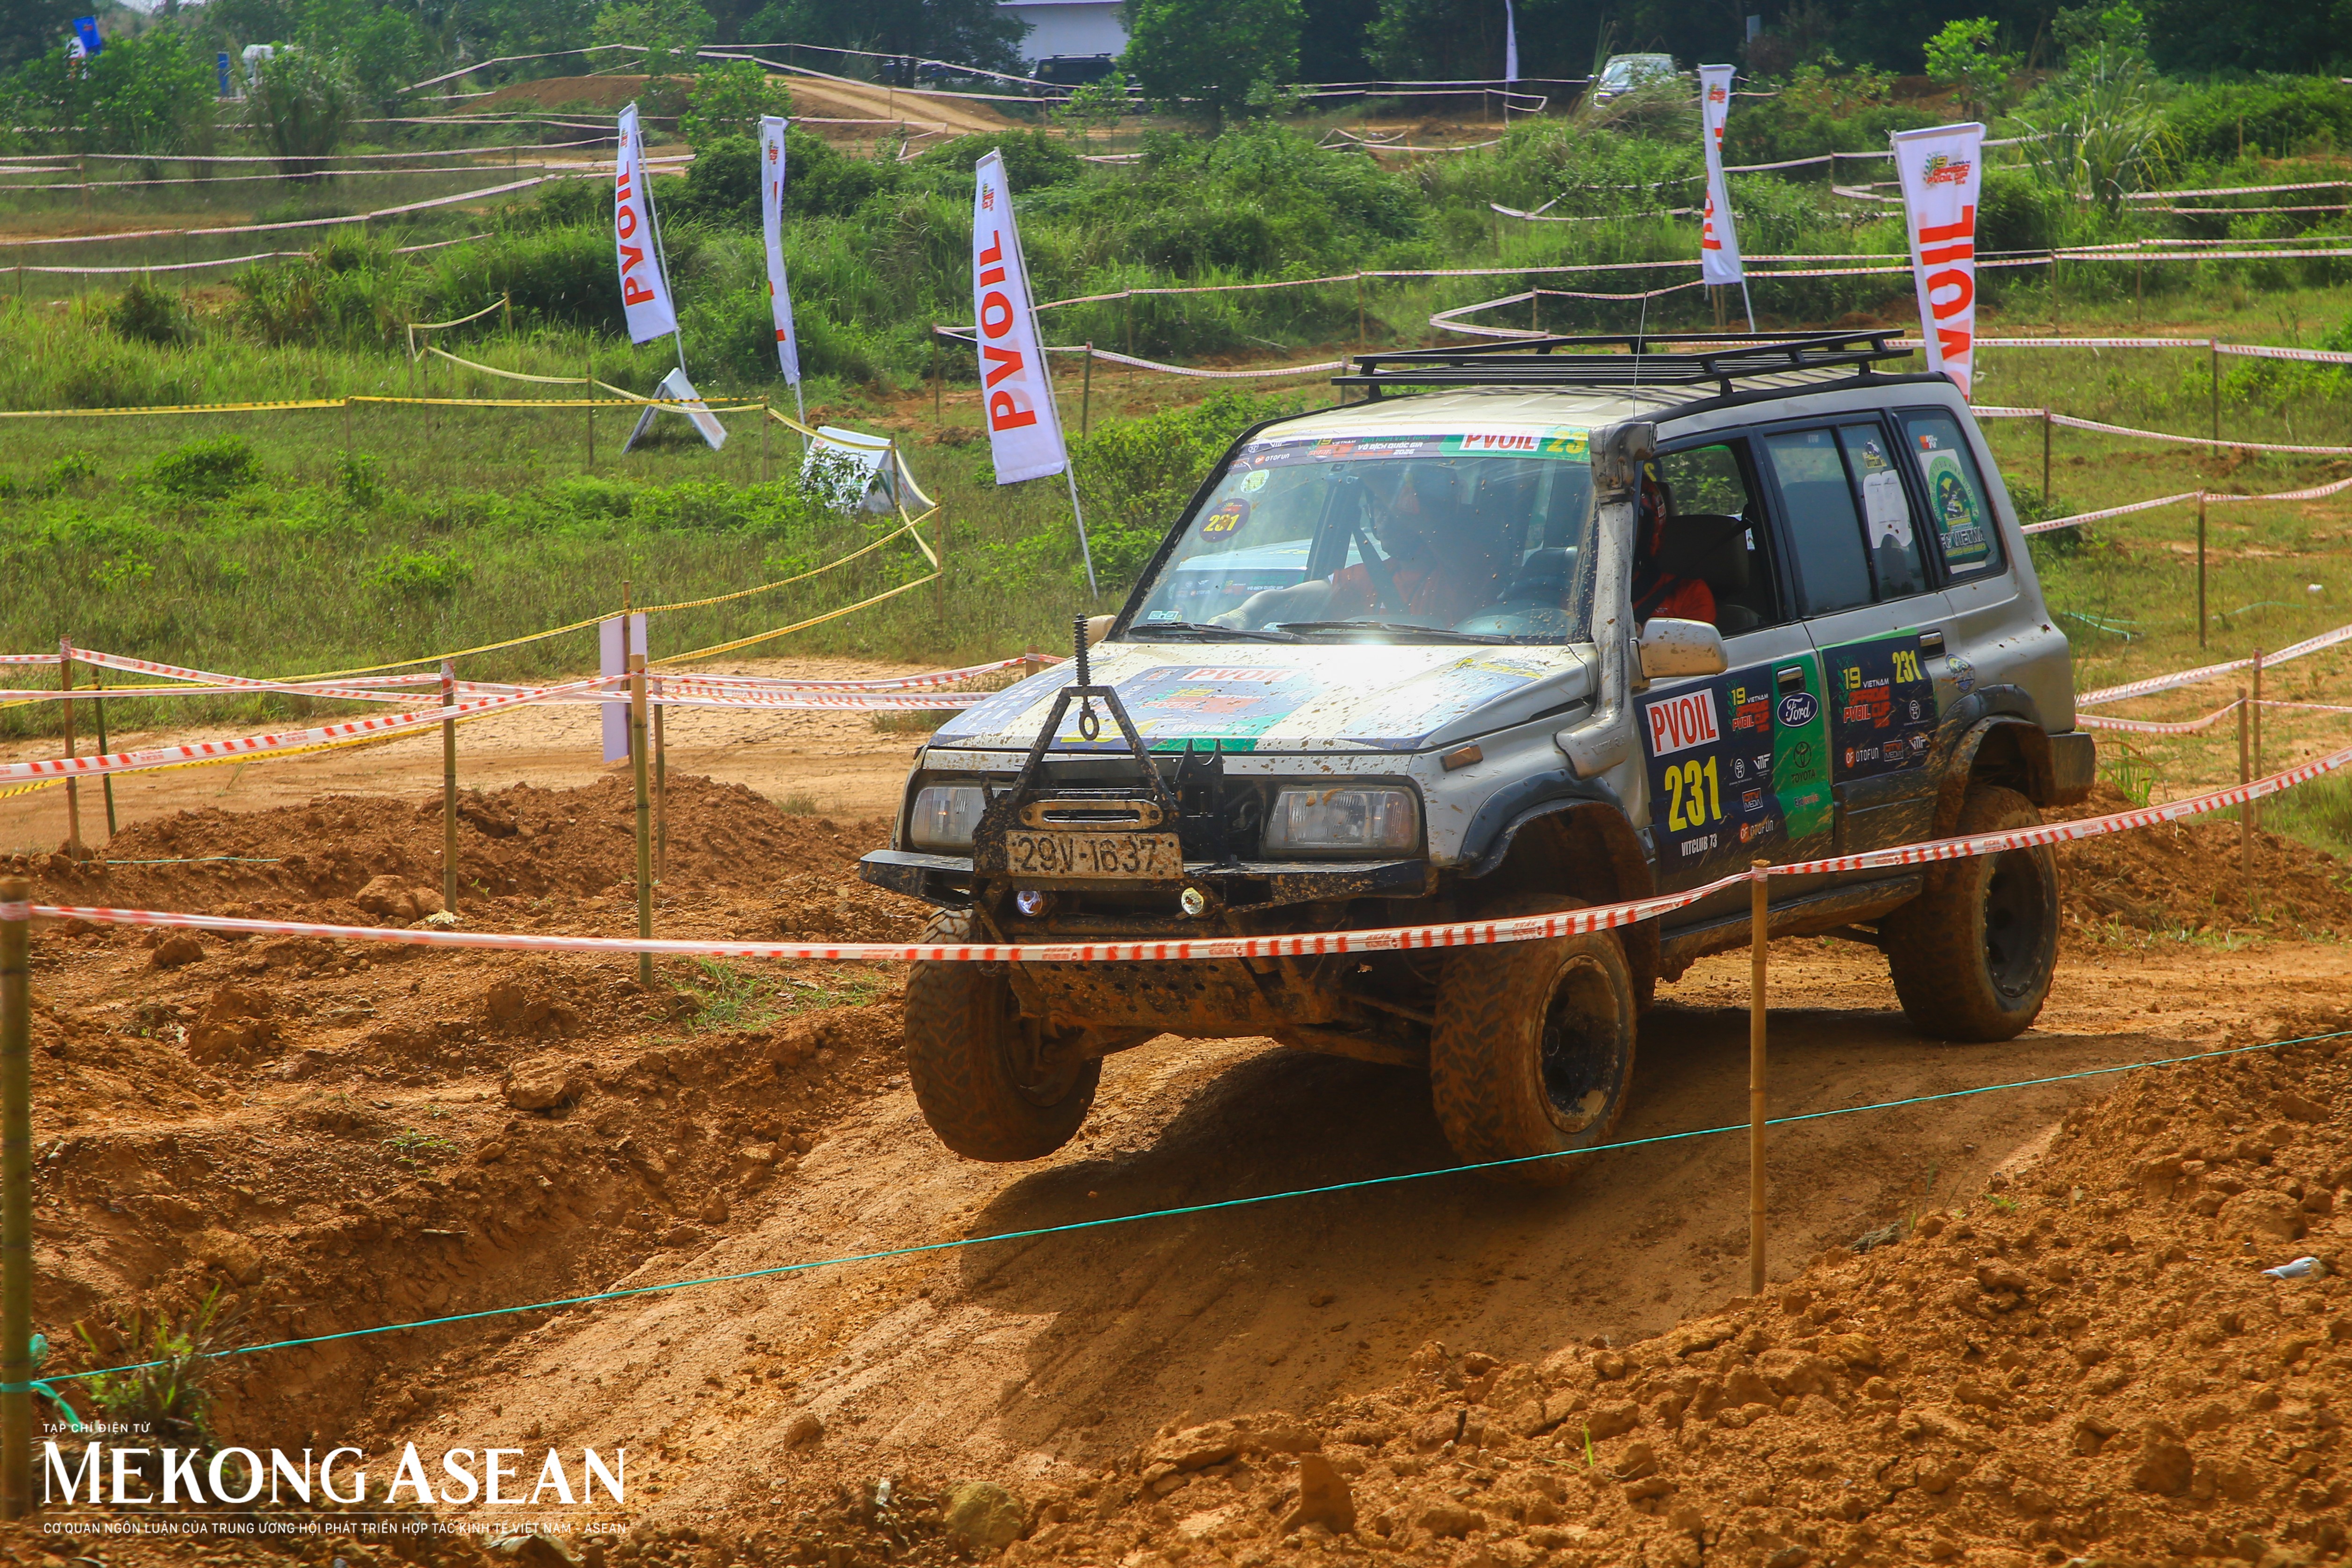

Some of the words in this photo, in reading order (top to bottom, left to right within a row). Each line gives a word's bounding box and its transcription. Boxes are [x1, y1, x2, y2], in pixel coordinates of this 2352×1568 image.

[617, 160, 656, 306] PVOIL
[1919, 205, 1974, 401] VOIL
[979, 230, 1037, 432] PVOIL
[1547, 430, 1590, 454] 23
[1184, 669, 1288, 681] PVOIL
[1843, 666, 1861, 689] 19
[1863, 678, 1889, 688] VIETNAM
[1892, 650, 1922, 683] 231
[1731, 687, 1746, 706] 19
[1747, 693, 1768, 703] VIETNAM
[1786, 697, 1811, 722] Ford
[1843, 704, 1871, 723] PVOIL
[1872, 702, 1891, 717] CUP
[1650, 694, 1716, 752] PVOIL
[1732, 715, 1754, 731] PVOIL
[1855, 748, 1878, 762] OTOFUN
[1791, 769, 1816, 784] TOYOTA
[1665, 756, 1722, 832] 231
[1745, 799, 1762, 809] MEDIA
[1018, 837, 1156, 873] 29V-1637
[1681, 836, 1708, 856] VITCLUB
[1709, 833, 1717, 848] 73
